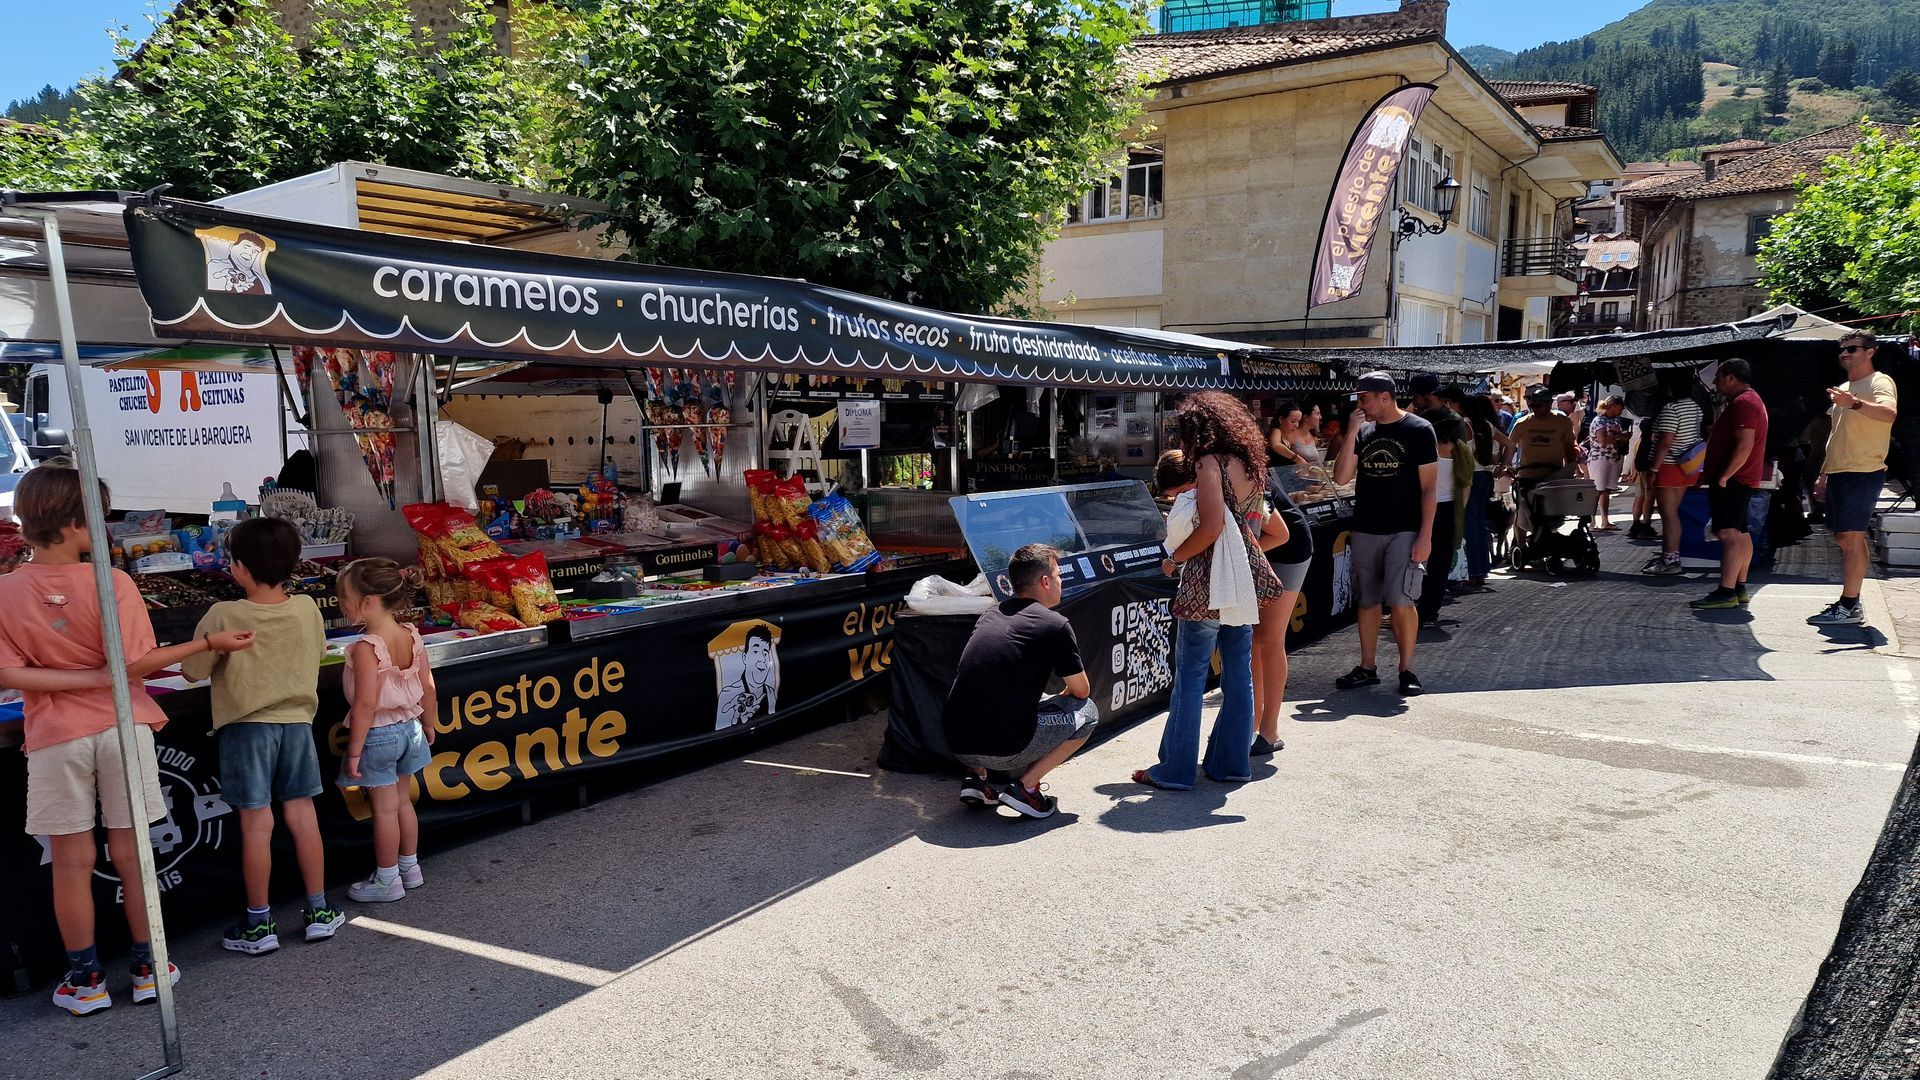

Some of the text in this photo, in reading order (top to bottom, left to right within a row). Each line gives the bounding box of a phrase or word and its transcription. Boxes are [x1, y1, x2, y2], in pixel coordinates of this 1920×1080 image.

[1332, 148, 1376, 257] el puesto de
[373, 266, 1208, 371] caramelos chucherías frutos secos fruta deshidratada aceitunas pinchos
[1622, 366, 1649, 381] RICO
[845, 408, 872, 417] DIPLOMA
[125, 425, 252, 446] SAN VICENTE DE LA BARQUERA
[976, 462, 1026, 473] PINCHOS
[655, 549, 713, 566] Gominolas
[551, 563, 602, 578] ramelos
[843, 602, 866, 636] el
[434, 673, 561, 735] uesto
[573, 656, 625, 699] de
[336, 706, 627, 821] cente
[158, 869, 183, 893] AÍS
